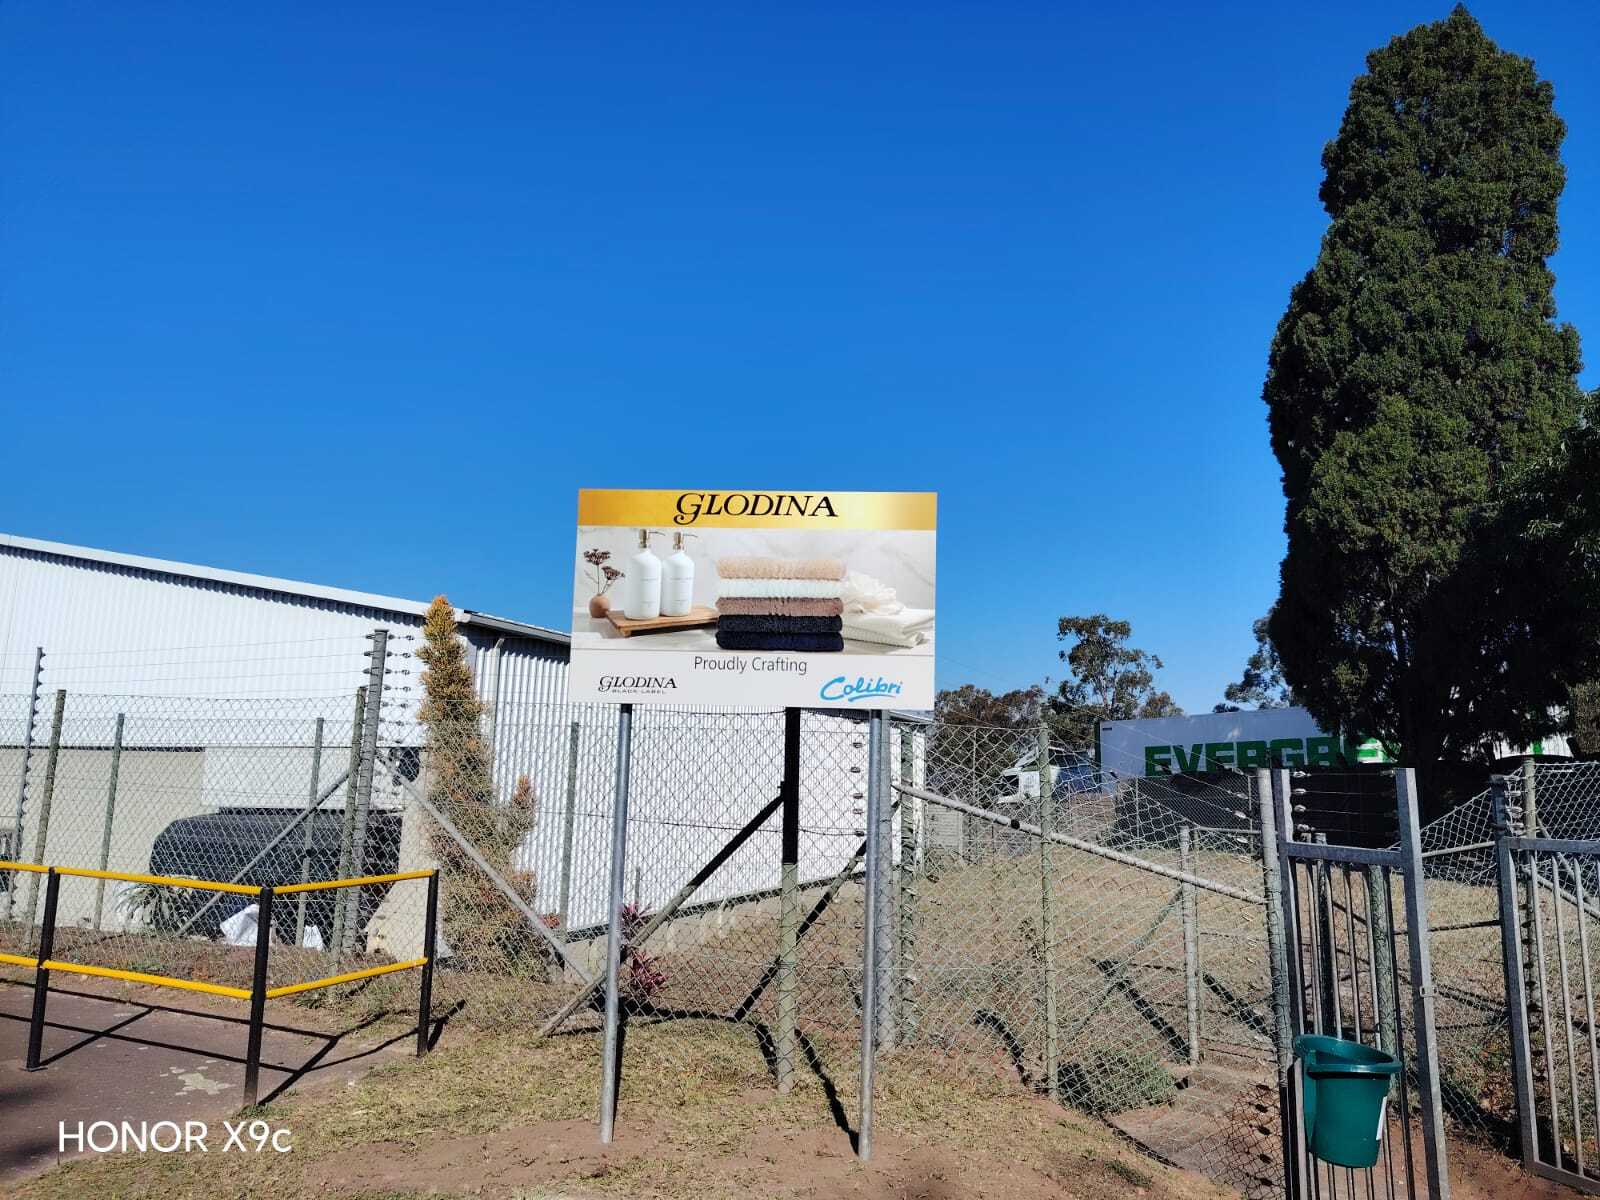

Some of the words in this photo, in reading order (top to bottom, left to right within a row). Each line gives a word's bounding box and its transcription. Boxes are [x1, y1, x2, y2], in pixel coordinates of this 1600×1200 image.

[673, 492, 838, 526] GLODINA
[694, 655, 747, 674] Proudly
[751, 656, 808, 676] Crafting
[598, 675, 678, 692] GLODINA
[820, 676, 903, 702] Colibri
